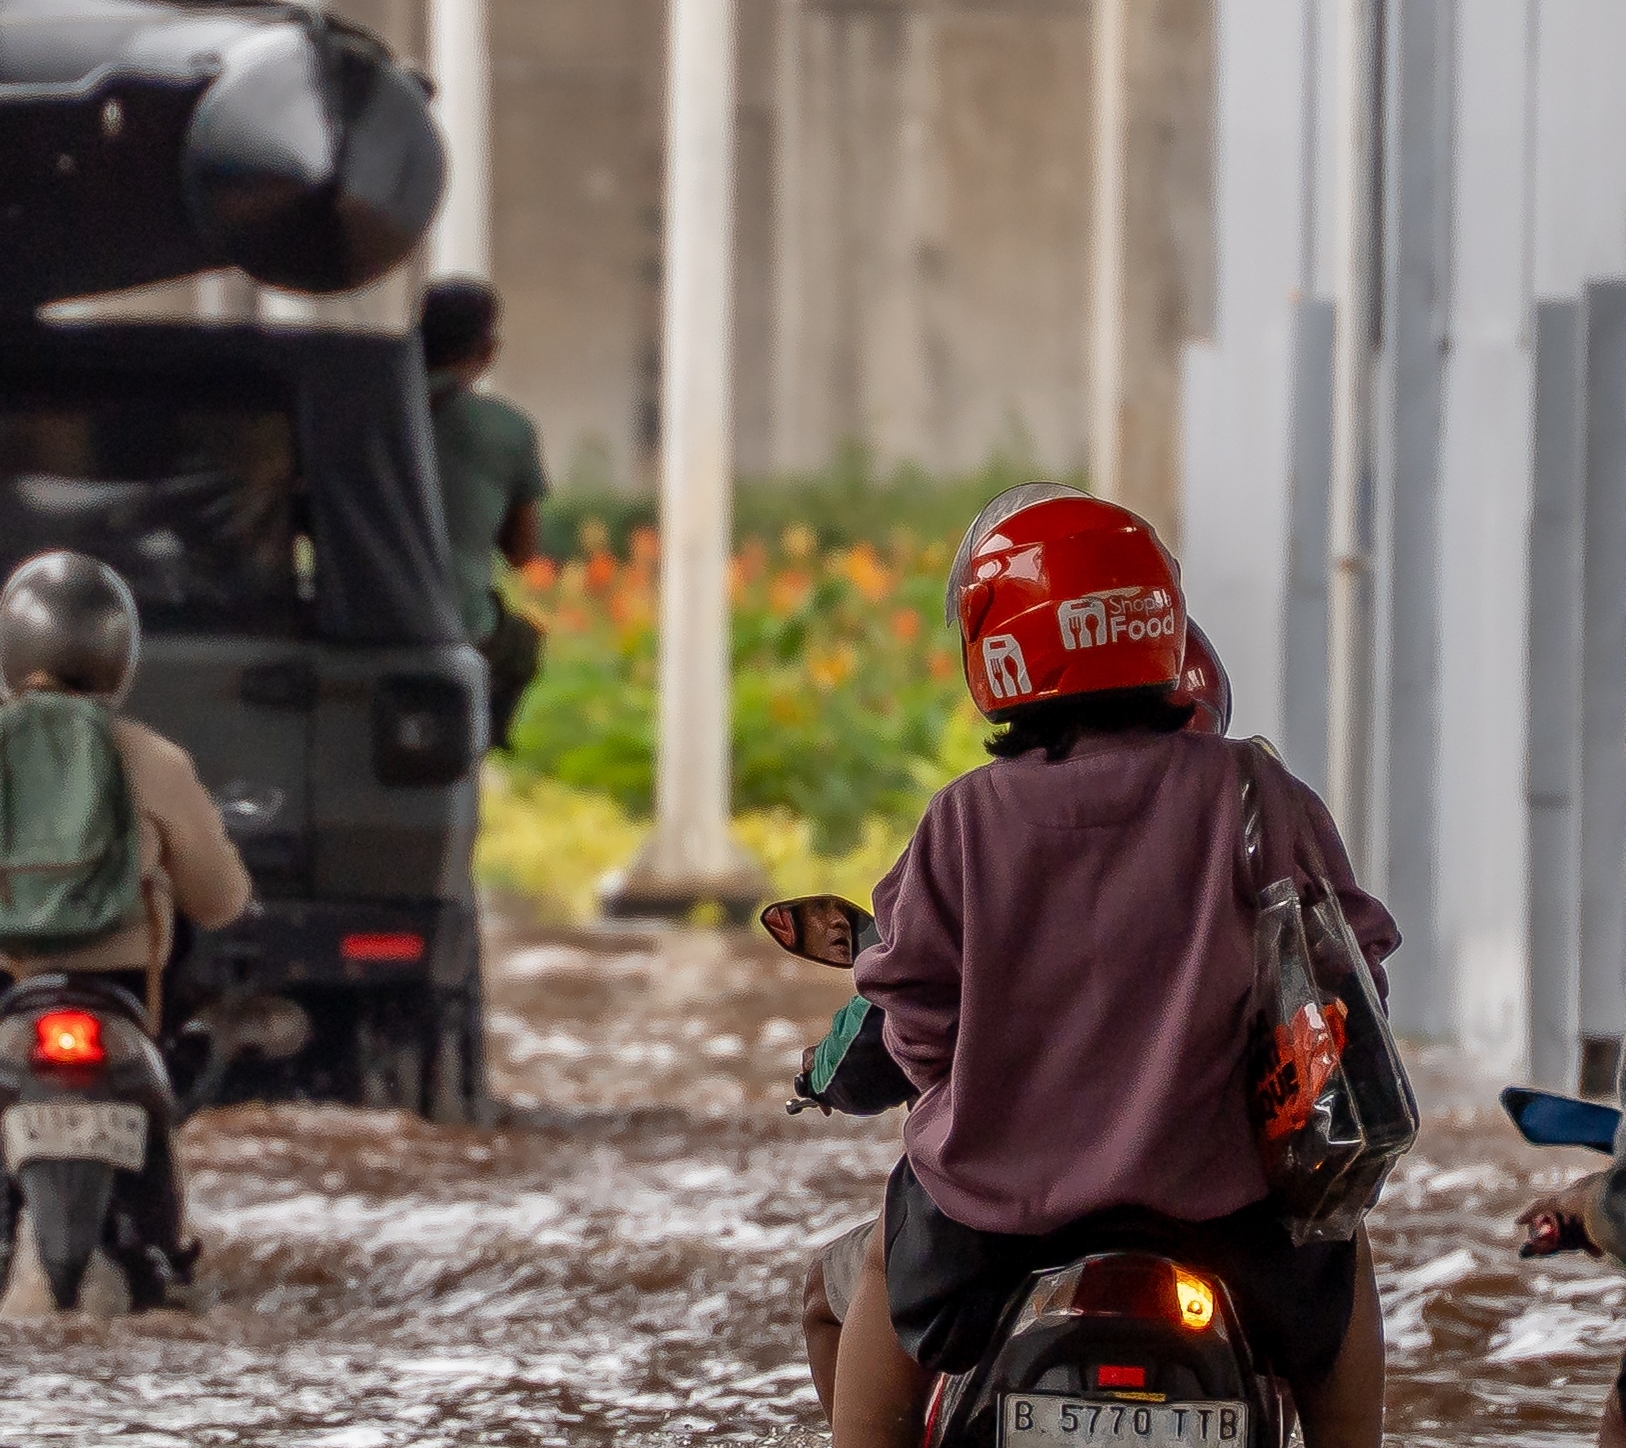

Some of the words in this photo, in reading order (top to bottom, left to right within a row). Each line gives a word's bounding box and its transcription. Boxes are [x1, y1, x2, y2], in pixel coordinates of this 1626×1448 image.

[1109, 607, 1175, 643] Food
[1014, 1400, 1035, 1432] B
[1061, 1404, 1152, 1437] 5770
[1172, 1408, 1239, 1441] TTB
